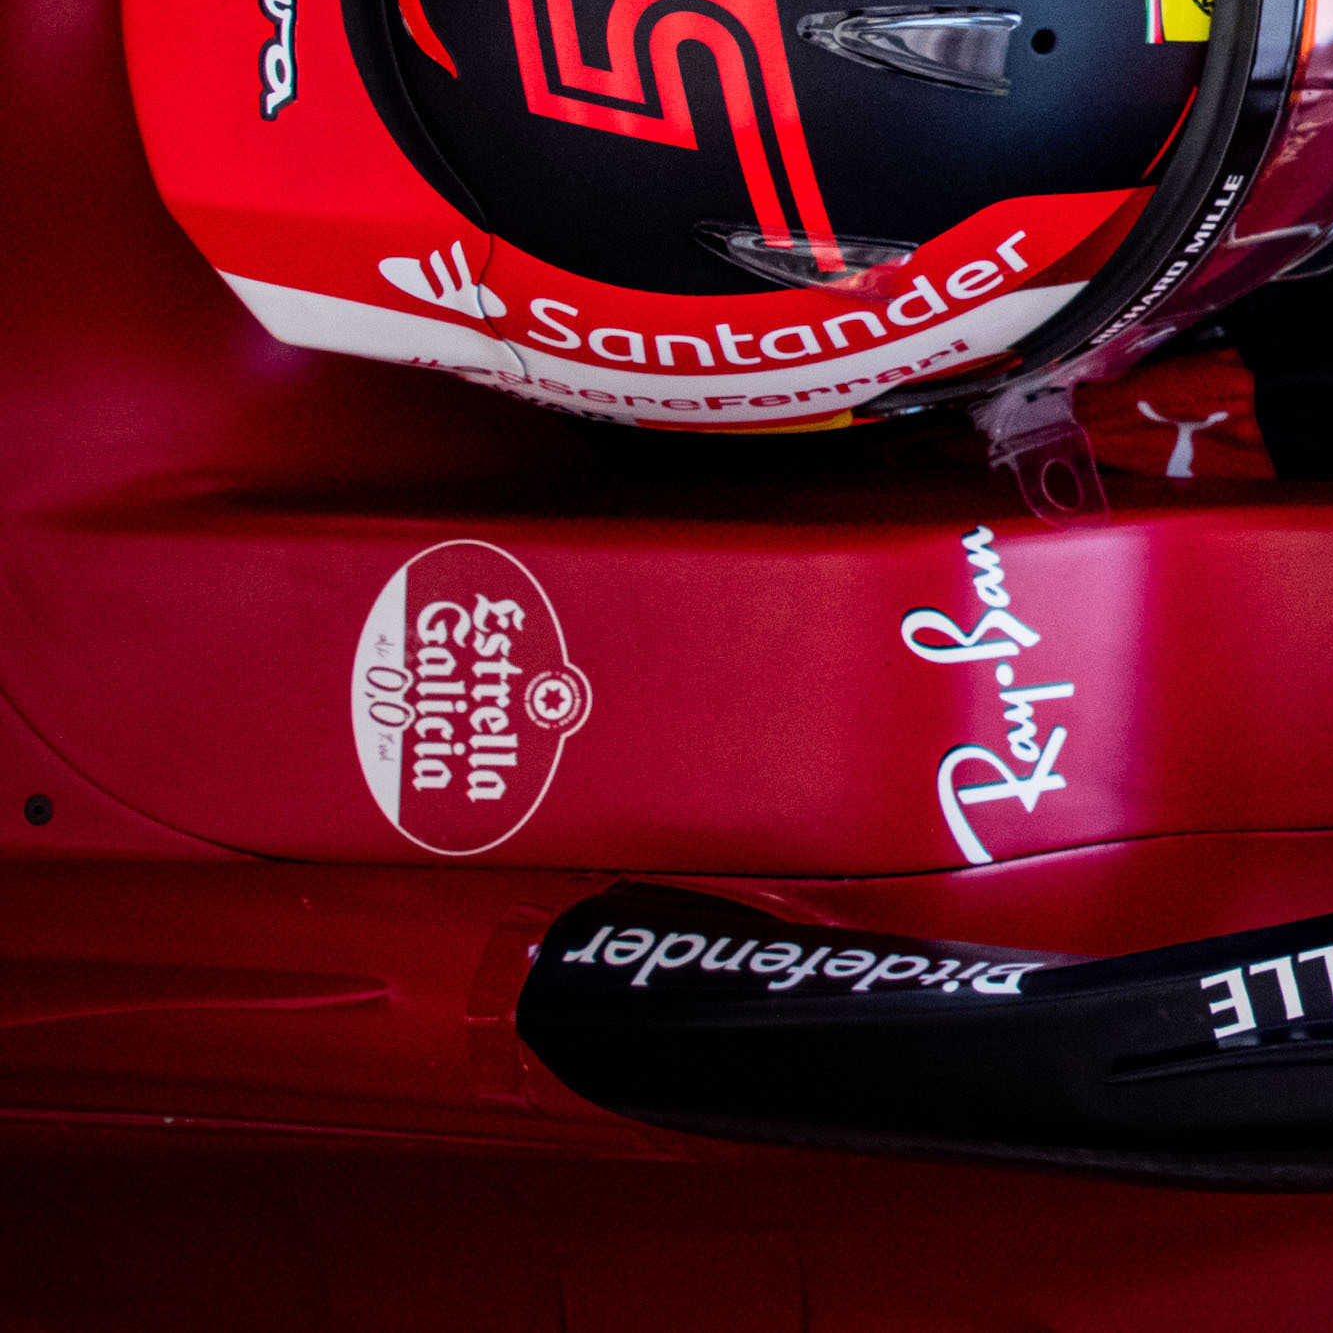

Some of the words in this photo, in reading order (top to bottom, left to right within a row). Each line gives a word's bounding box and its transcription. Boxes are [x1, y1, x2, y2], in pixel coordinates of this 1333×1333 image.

[1184, 174, 1244, 254] MILLE
[526, 230, 1029, 369] Santander
[412, 600, 471, 792] Galicia
[466, 593, 526, 802] Estrella
[563, 925, 1046, 994] Bitdefender
